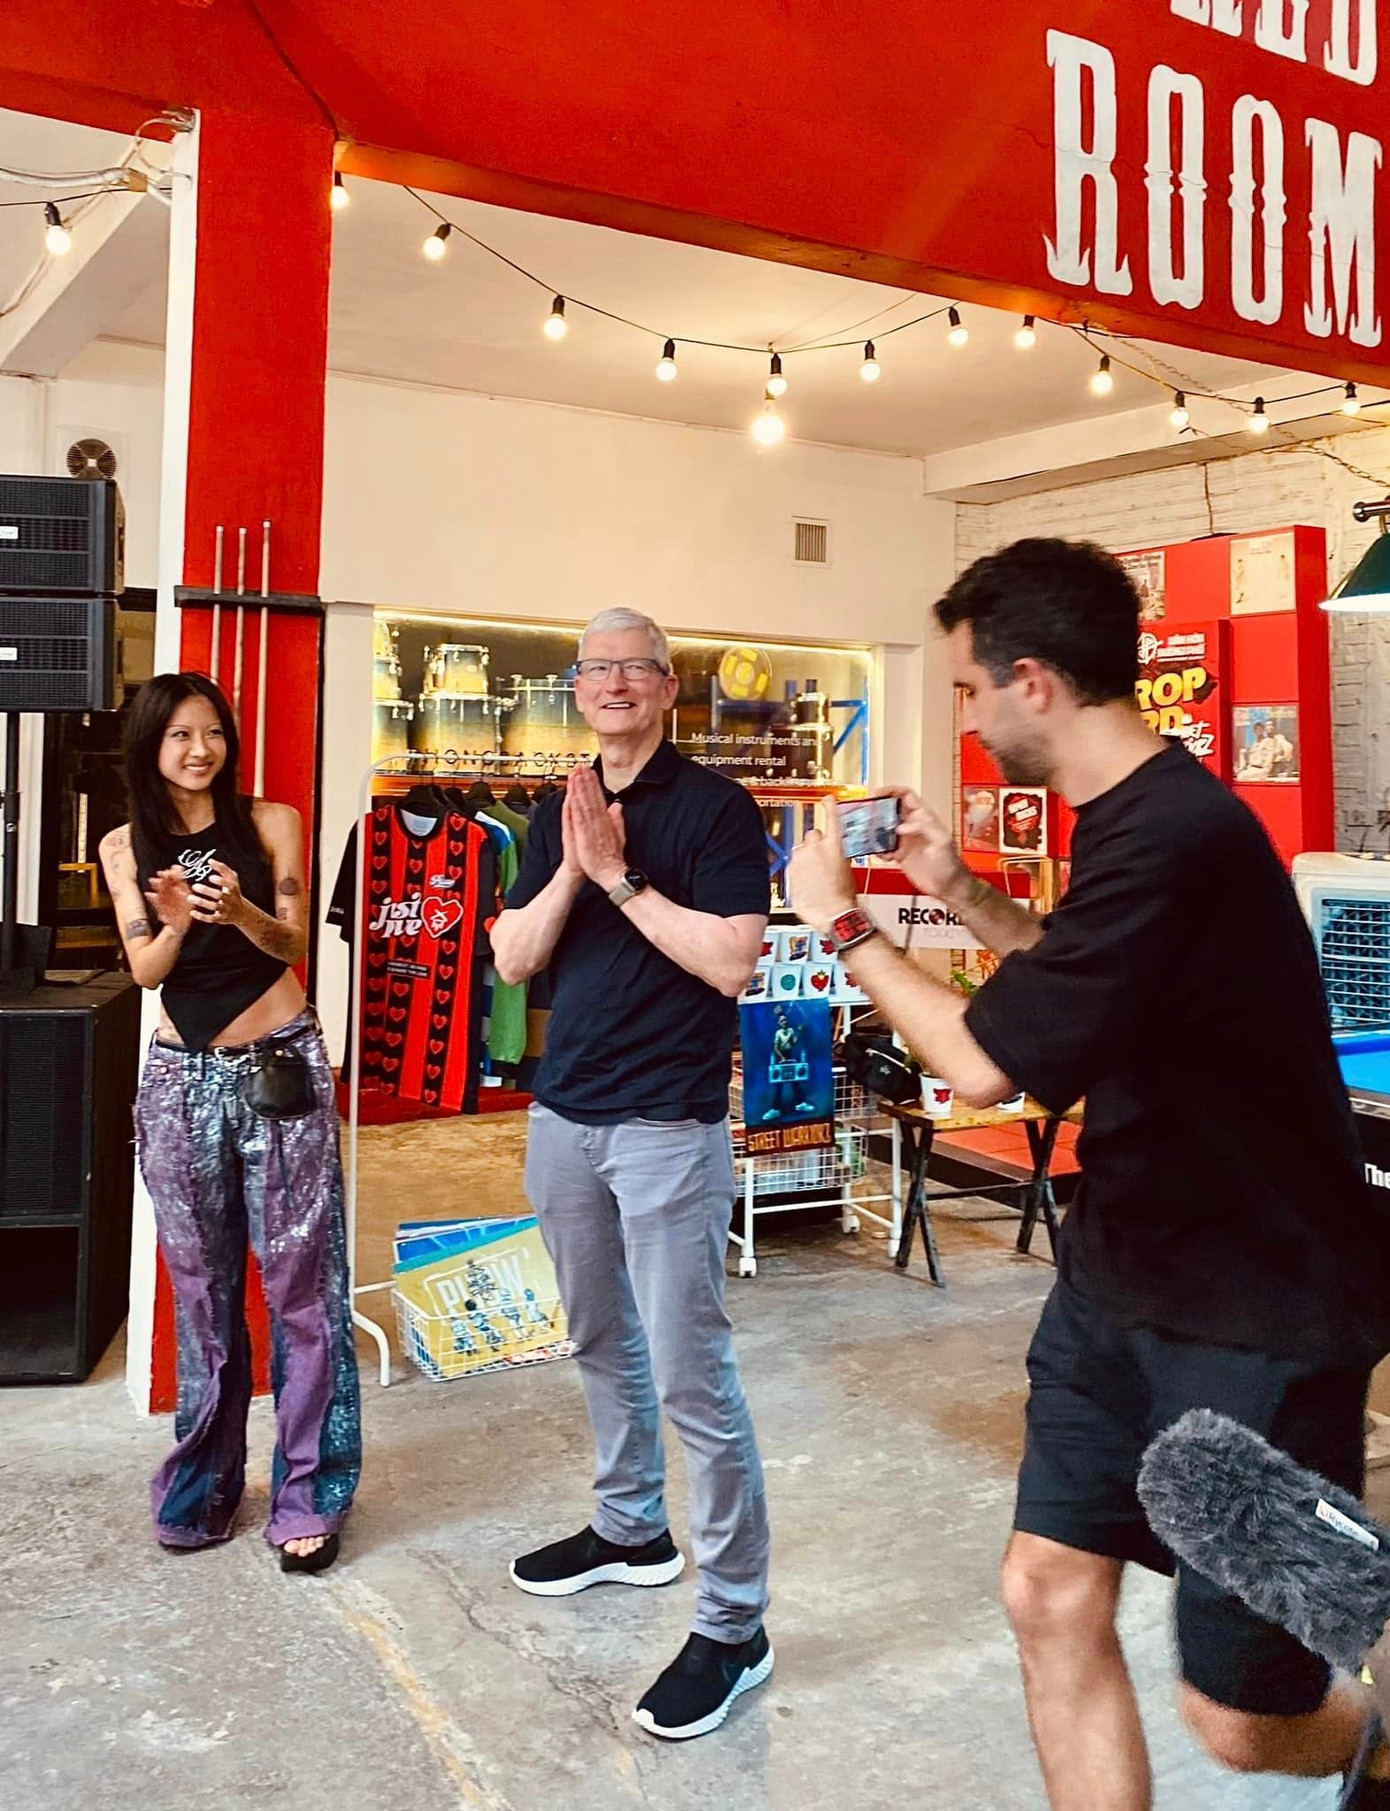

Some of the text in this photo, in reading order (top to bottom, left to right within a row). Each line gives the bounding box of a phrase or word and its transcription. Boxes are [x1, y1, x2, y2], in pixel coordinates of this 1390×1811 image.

[1042, 30, 1384, 348] ROOM
[691, 732, 733, 744] Musical
[735, 734, 800, 747] instruments
[691, 753, 786, 766] equipment rental
[898, 907, 970, 926] RECOR
[747, 1130, 781, 1152] STREET
